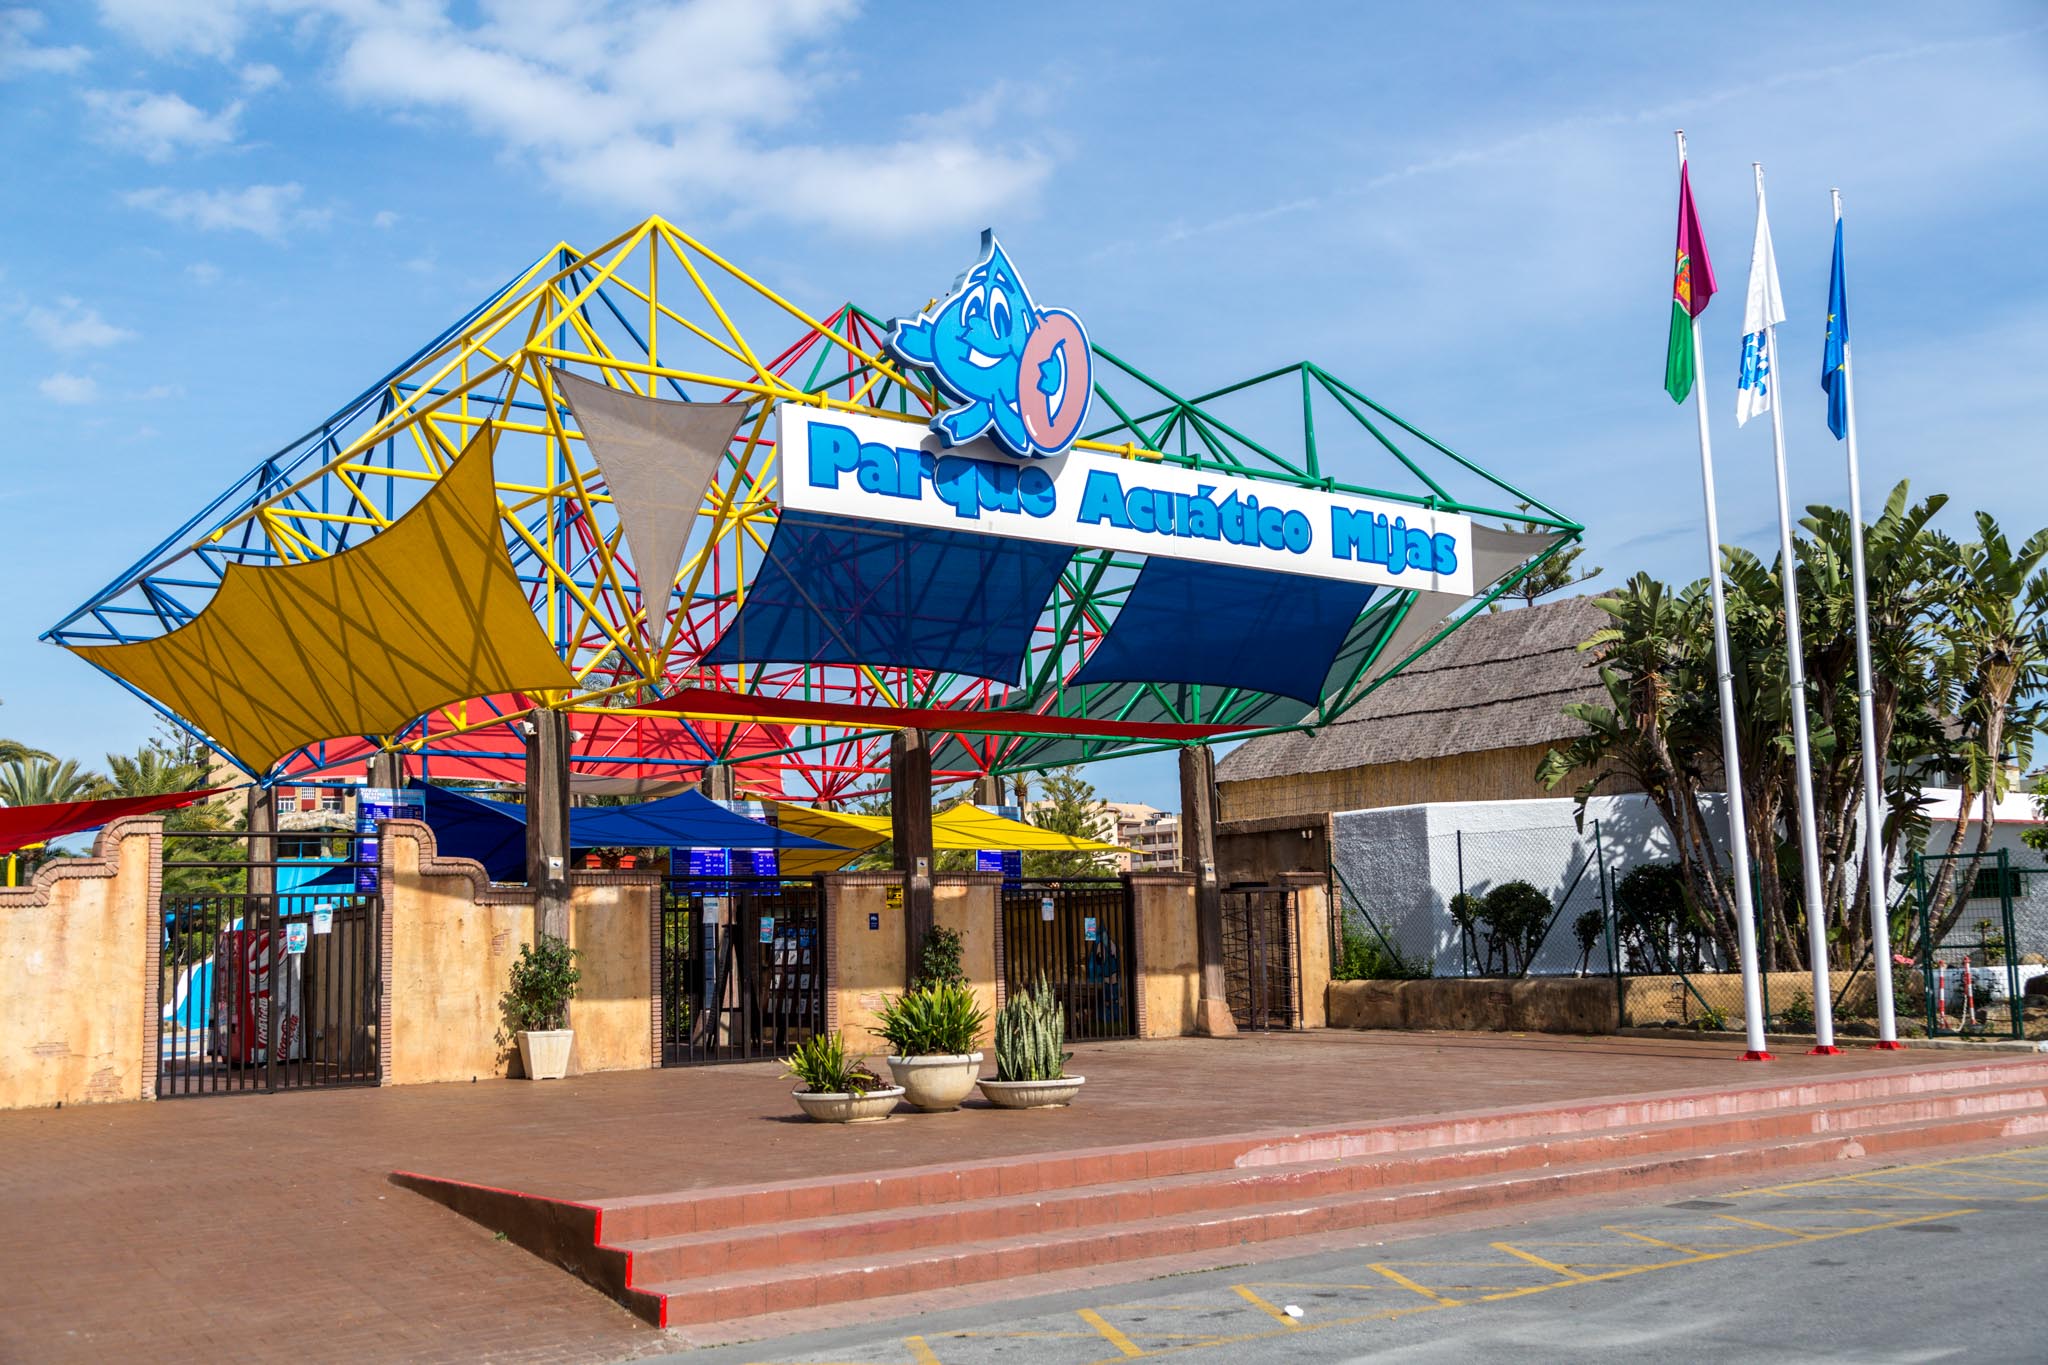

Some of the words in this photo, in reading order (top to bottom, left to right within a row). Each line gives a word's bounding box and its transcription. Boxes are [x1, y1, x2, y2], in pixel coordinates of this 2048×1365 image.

[807, 421, 1057, 519] Parque
[1077, 469, 1313, 554] Acuático
[1331, 505, 1458, 575] Mijas
